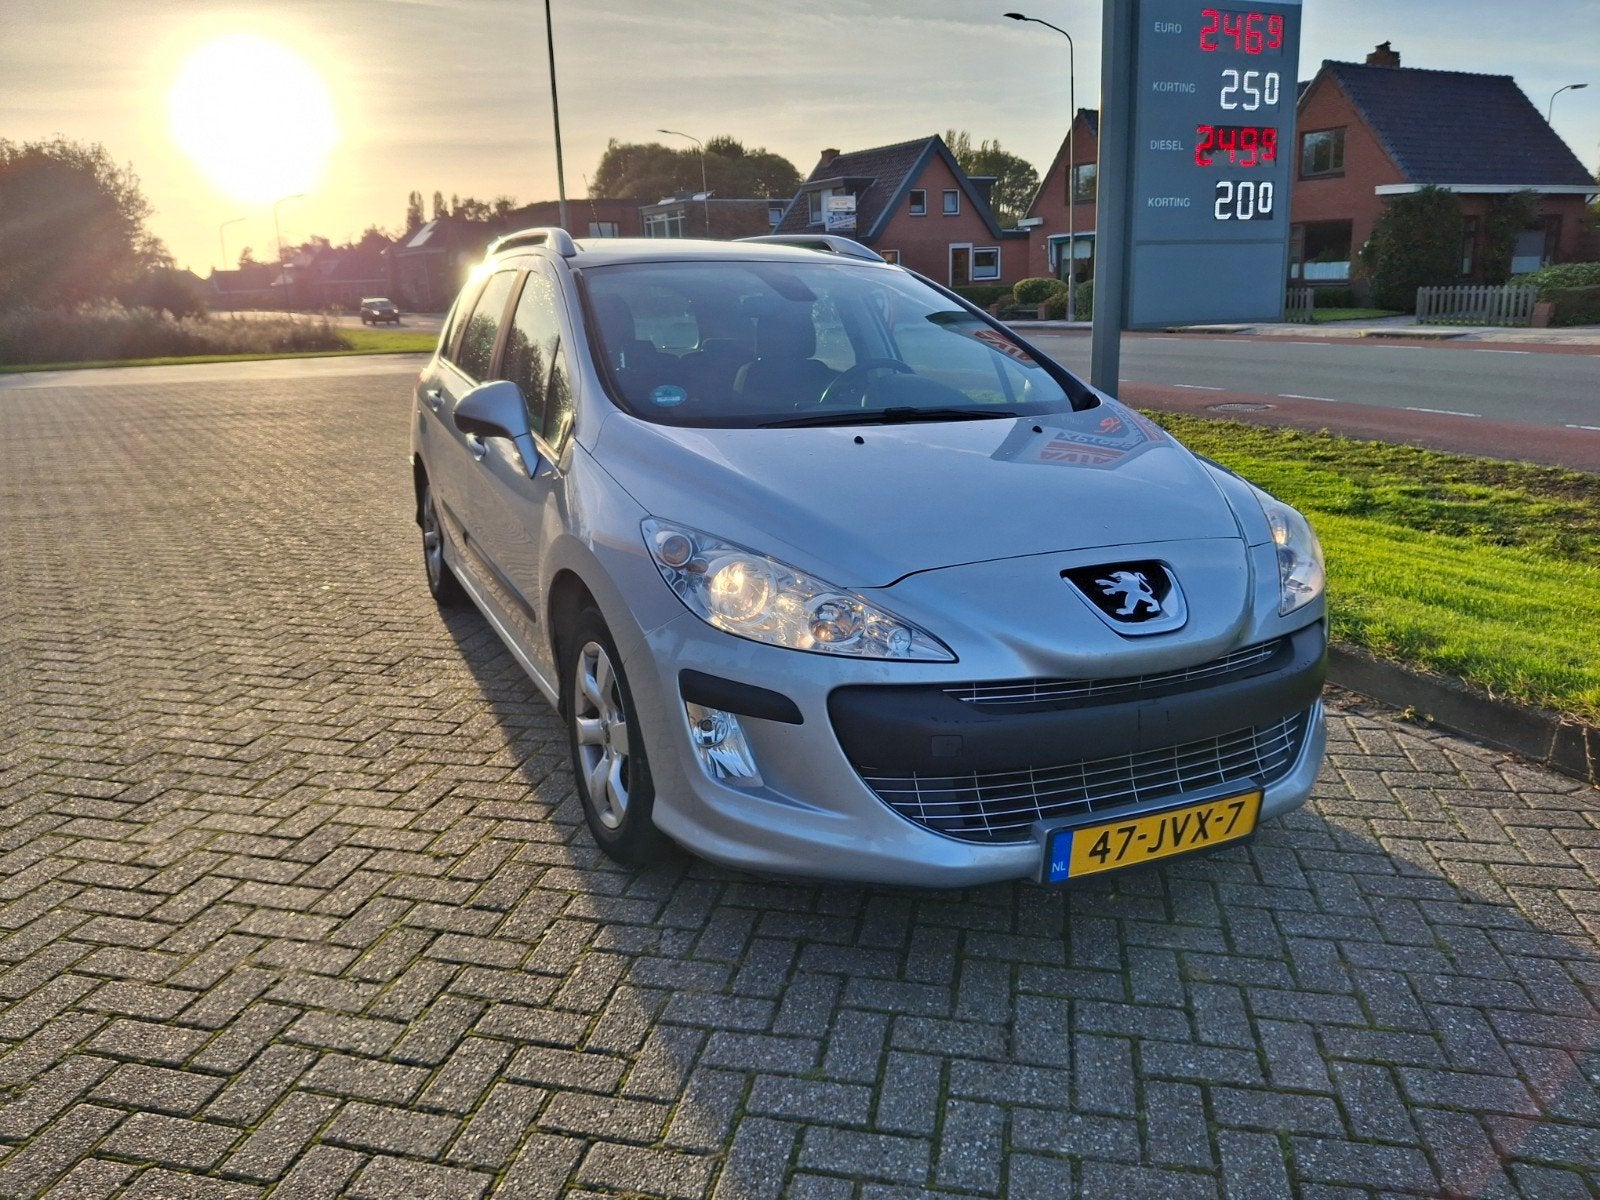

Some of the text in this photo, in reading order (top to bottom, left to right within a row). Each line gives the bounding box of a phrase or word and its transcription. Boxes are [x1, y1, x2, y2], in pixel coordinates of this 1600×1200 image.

[1154, 8, 1284, 55] EURO 2469
[1152, 69, 1280, 111] KORTING 250
[1150, 124, 1278, 167] DIESEL 2499
[1148, 181, 1274, 220] KORTING 200
[1088, 801, 1246, 864] 47-JVX-7
[1051, 862, 1066, 873] NL
